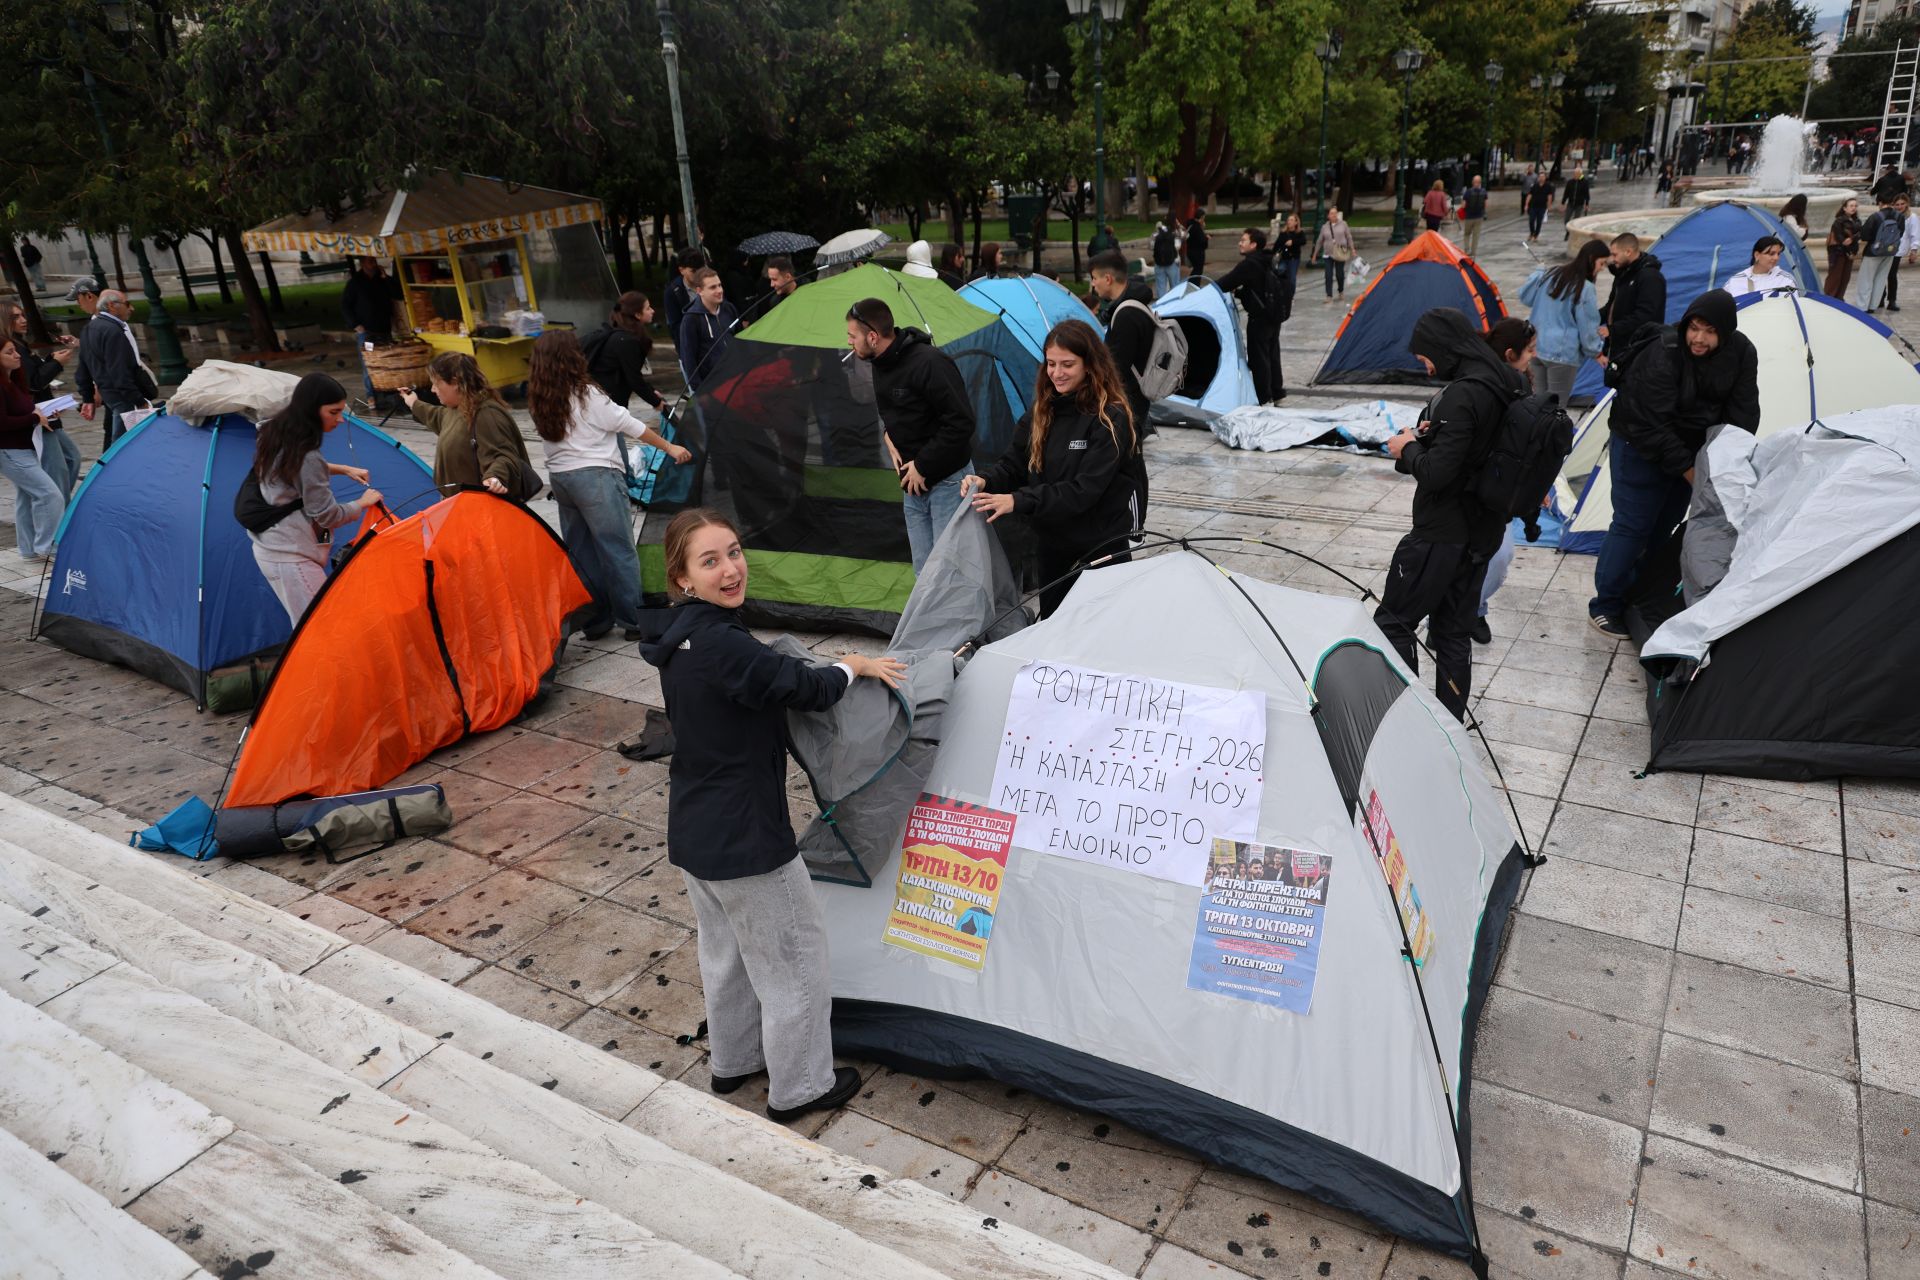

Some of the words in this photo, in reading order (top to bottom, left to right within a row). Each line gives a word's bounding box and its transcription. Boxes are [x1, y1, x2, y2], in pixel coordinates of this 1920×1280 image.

[1032, 665, 1185, 726] ΦΟΙΤΗΤΙΚΗ
[1109, 727, 1193, 760] ΣΤΕΓΗ
[1203, 736, 1264, 772] 2026
[1037, 750, 1167, 793] ΚΑΤΑΣΤΑΣΗ
[1190, 777, 1246, 808] ΜΟΥ
[1000, 785, 1058, 817] ΜΕΤΑ
[1076, 798, 1102, 824] ΤΟ
[910, 819, 924, 829] ΓΙΑ
[924, 820, 935, 830] ΤΟ
[936, 822, 969, 836] ΚΟΣΤΟΣ
[969, 827, 1009, 844] ΣΠΟΥΔΩΝ
[914, 807, 943, 820] ΜΕΤΡΑ
[944, 811, 985, 826] ΣΤΗΡΙΞΗΣ
[985, 817, 1010, 831] ΤΩΡΑ!
[908, 829, 916, 838] &
[917, 830, 927, 840] ΤΗ
[928, 833, 973, 848] ΦΟΙΤΗΤΙΚΗ
[973, 839, 1002, 853] ΣΤΕΓΗ!
[905, 851, 951, 878] ΤΡΙΤΗ
[953, 863, 998, 892] 13/10
[901, 872, 993, 908] ΚΑΤΑΣΚΗΝΩΝΟΥΜΕ
[1213, 876, 1246, 891] ΜΕΤΡΑ
[1247, 881, 1295, 897] ΣΤΗΡΙΞΗΣ
[1295, 887, 1322, 901] ΤΩΡΑ
[1221, 889, 1233, 899] ΓΙΑ
[1234, 891, 1244, 900] ΤΟ
[1244, 892, 1271, 903] ΚΟΣΤΟΣ
[1271, 895, 1307, 908] ΣΠΟΥΔΩΝ
[896, 899, 958, 929] ΣΥΝΤΑΓΜΑ!
[932, 894, 955, 911] ΣΤΟ
[1212, 895, 1227, 906] ΚΑΙ
[1227, 898, 1239, 907] ΤΗ
[1239, 901, 1285, 914] ΦΟΙΤΗΤΙΚΗ
[1285, 906, 1314, 918] ΣΤΕΓΗ!
[1204, 910, 1238, 926] ΤΡΙΤΗ
[1240, 915, 1254, 928] 13
[1255, 918, 1315, 938] ΟΚΤΩΒΡΗ
[1264, 932, 1276, 942] ΣΤΟ
[1276, 934, 1307, 947] ΣΥΝΤΑΓΜΑ
[1221, 954, 1284, 974] ΣΥΓΚΕΝΤΡΩΣΗ
